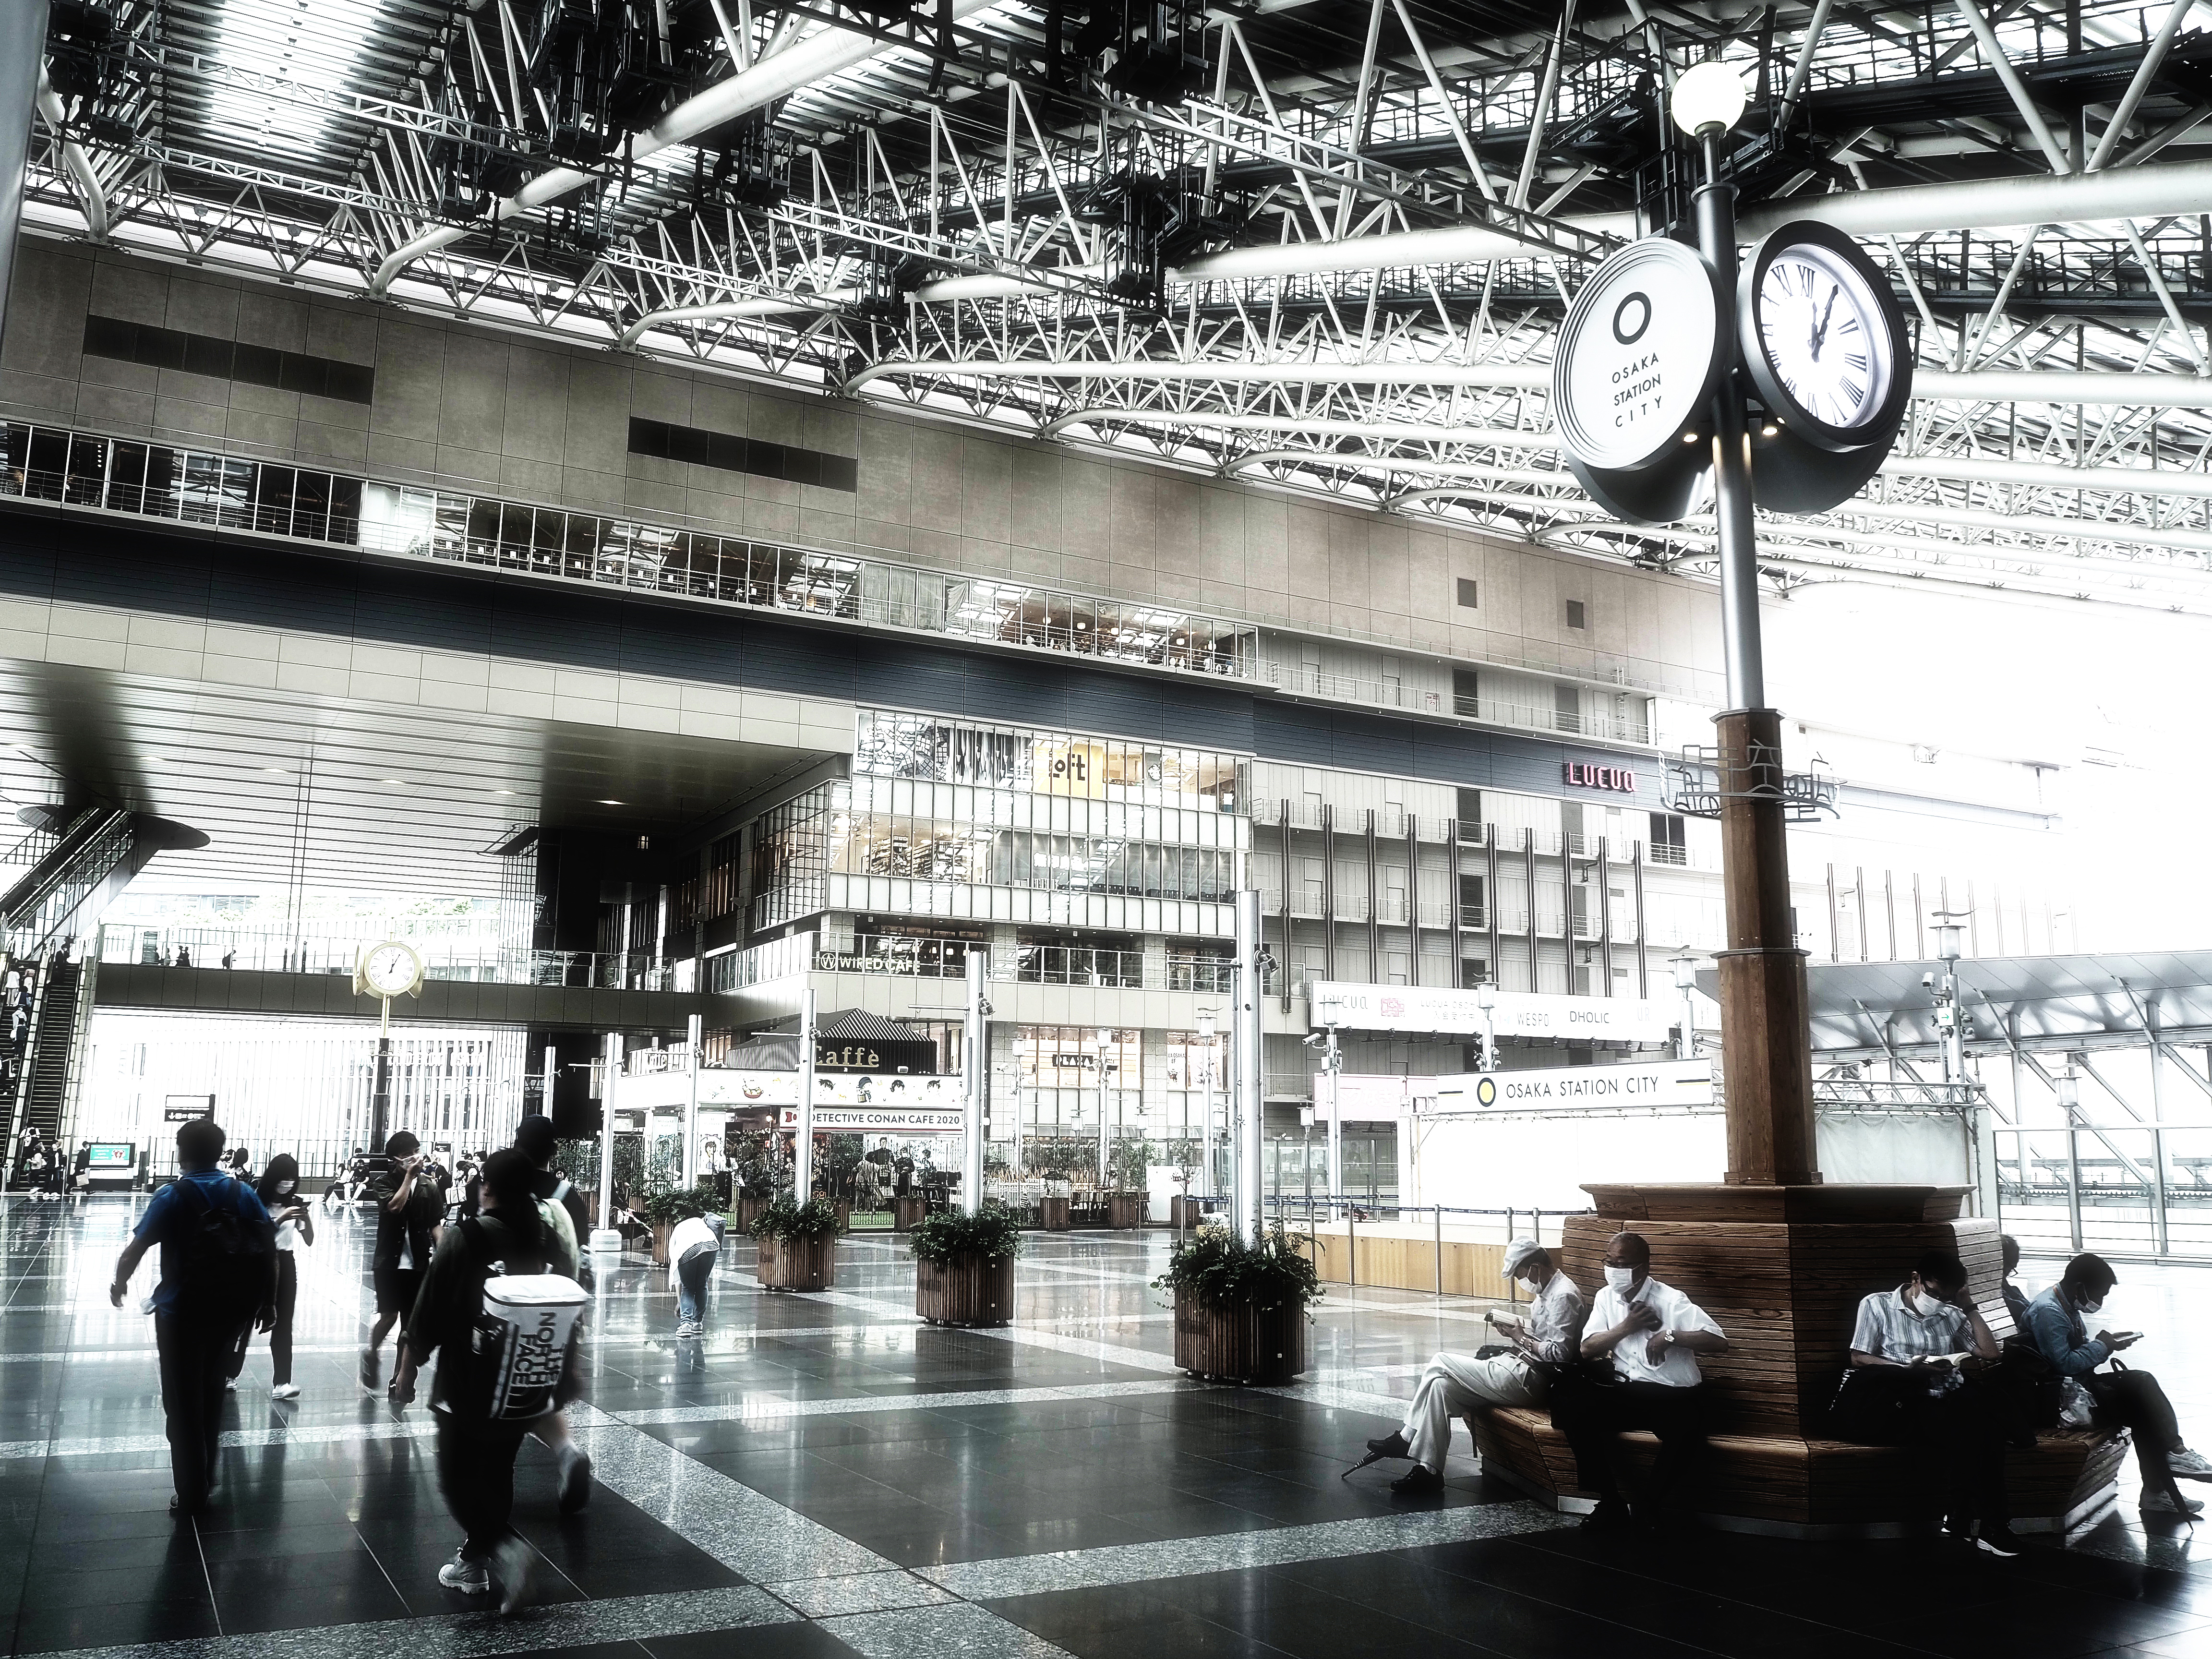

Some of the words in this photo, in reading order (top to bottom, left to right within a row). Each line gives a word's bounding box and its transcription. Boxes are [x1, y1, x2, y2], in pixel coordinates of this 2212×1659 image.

[1612, 352, 1659, 384] OSAKA
[1614, 373, 1661, 406] STATION
[1615, 396, 1662, 427] CITY
[840, 956, 883, 970] WIRED
[885, 959, 921, 973] CAFE
[1570, 1011, 1610, 1023] DHOLIC
[1056, 1056, 1091, 1066] PLAZA
[1506, 1082, 1552, 1098] OSAKA
[1560, 1079, 1618, 1096] STATION
[1626, 1076, 1659, 1094] CITY
[867, 1114, 905, 1124] CONAN
[908, 1115, 934, 1124] CAFE
[937, 1116, 960, 1124] 2020
[512, 1334, 537, 1385] FACE
[527, 1311, 556, 1385] NORTH
